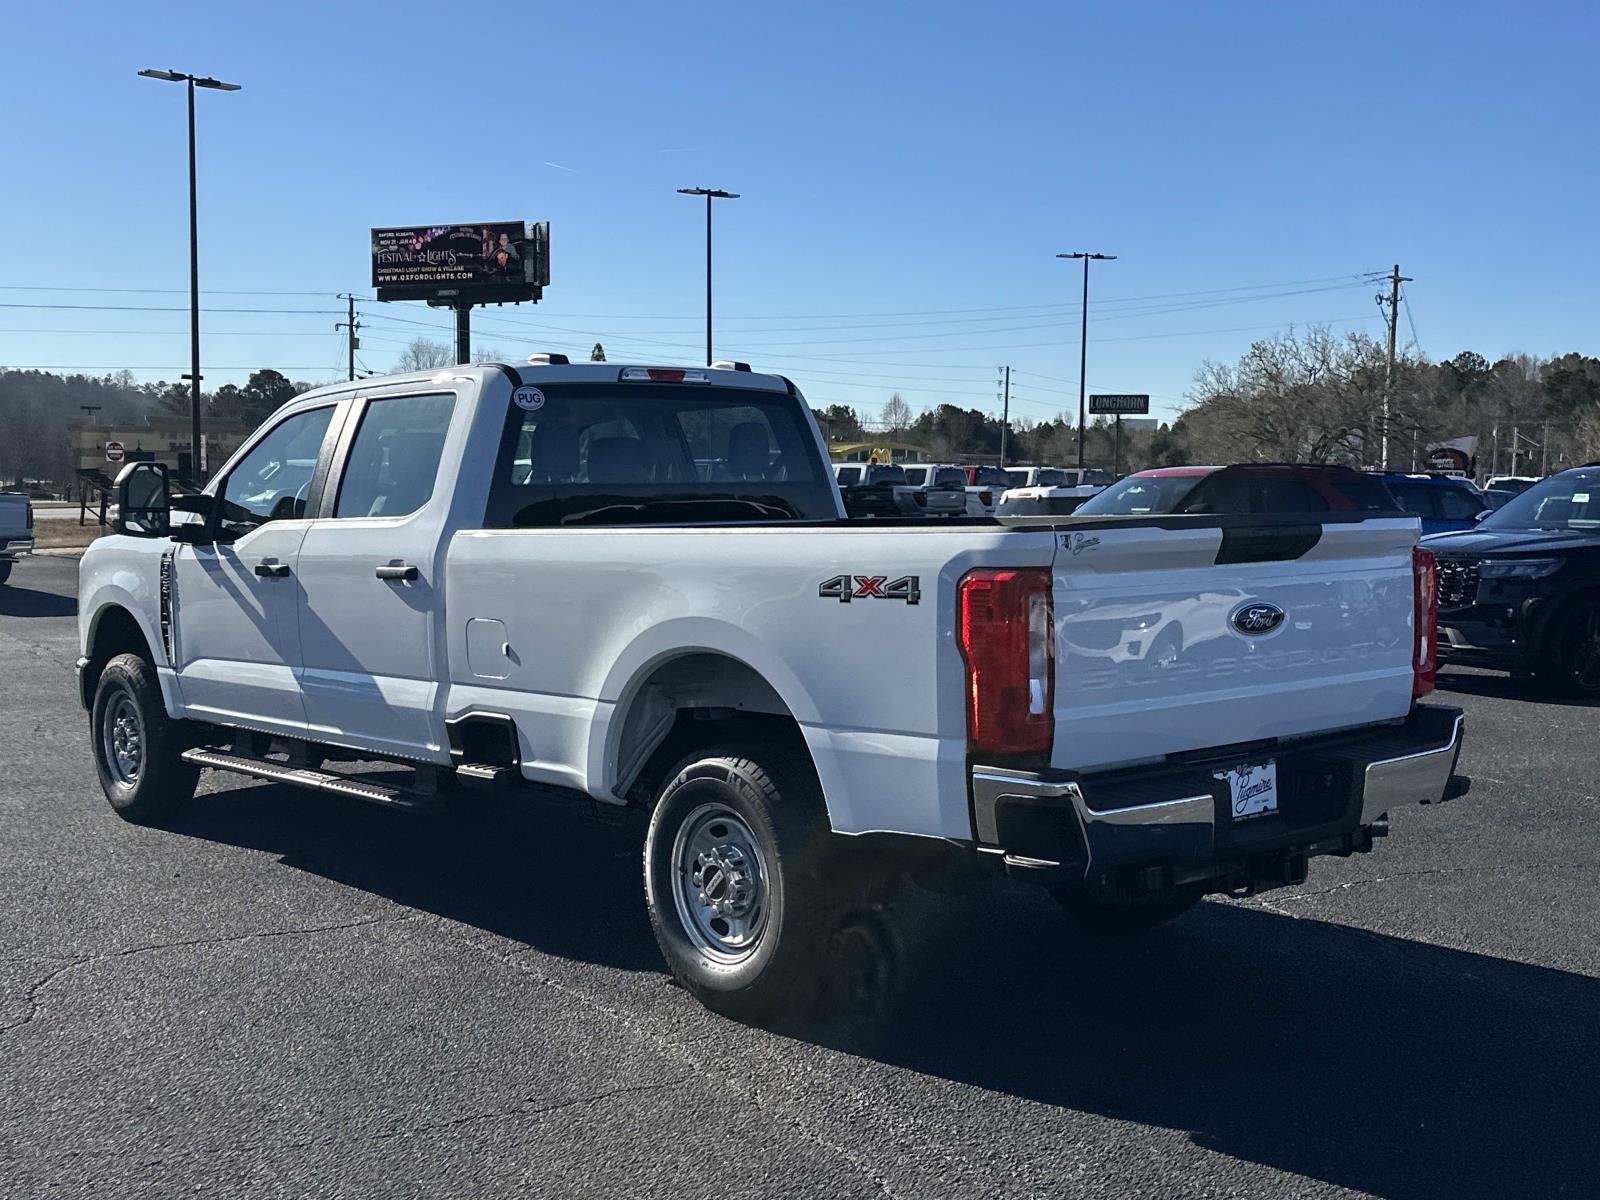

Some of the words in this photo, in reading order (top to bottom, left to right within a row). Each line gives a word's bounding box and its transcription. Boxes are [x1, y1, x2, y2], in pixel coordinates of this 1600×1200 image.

[377, 248, 413, 264] FESTIVAL
[427, 248, 457, 265] LIGHTS
[377, 273, 473, 282] WWW.OXFORDLIGHTS.COM
[518, 393, 541, 404] PUG
[1090, 396, 1145, 409] LONGHORN
[1243, 608, 1275, 629] Ford
